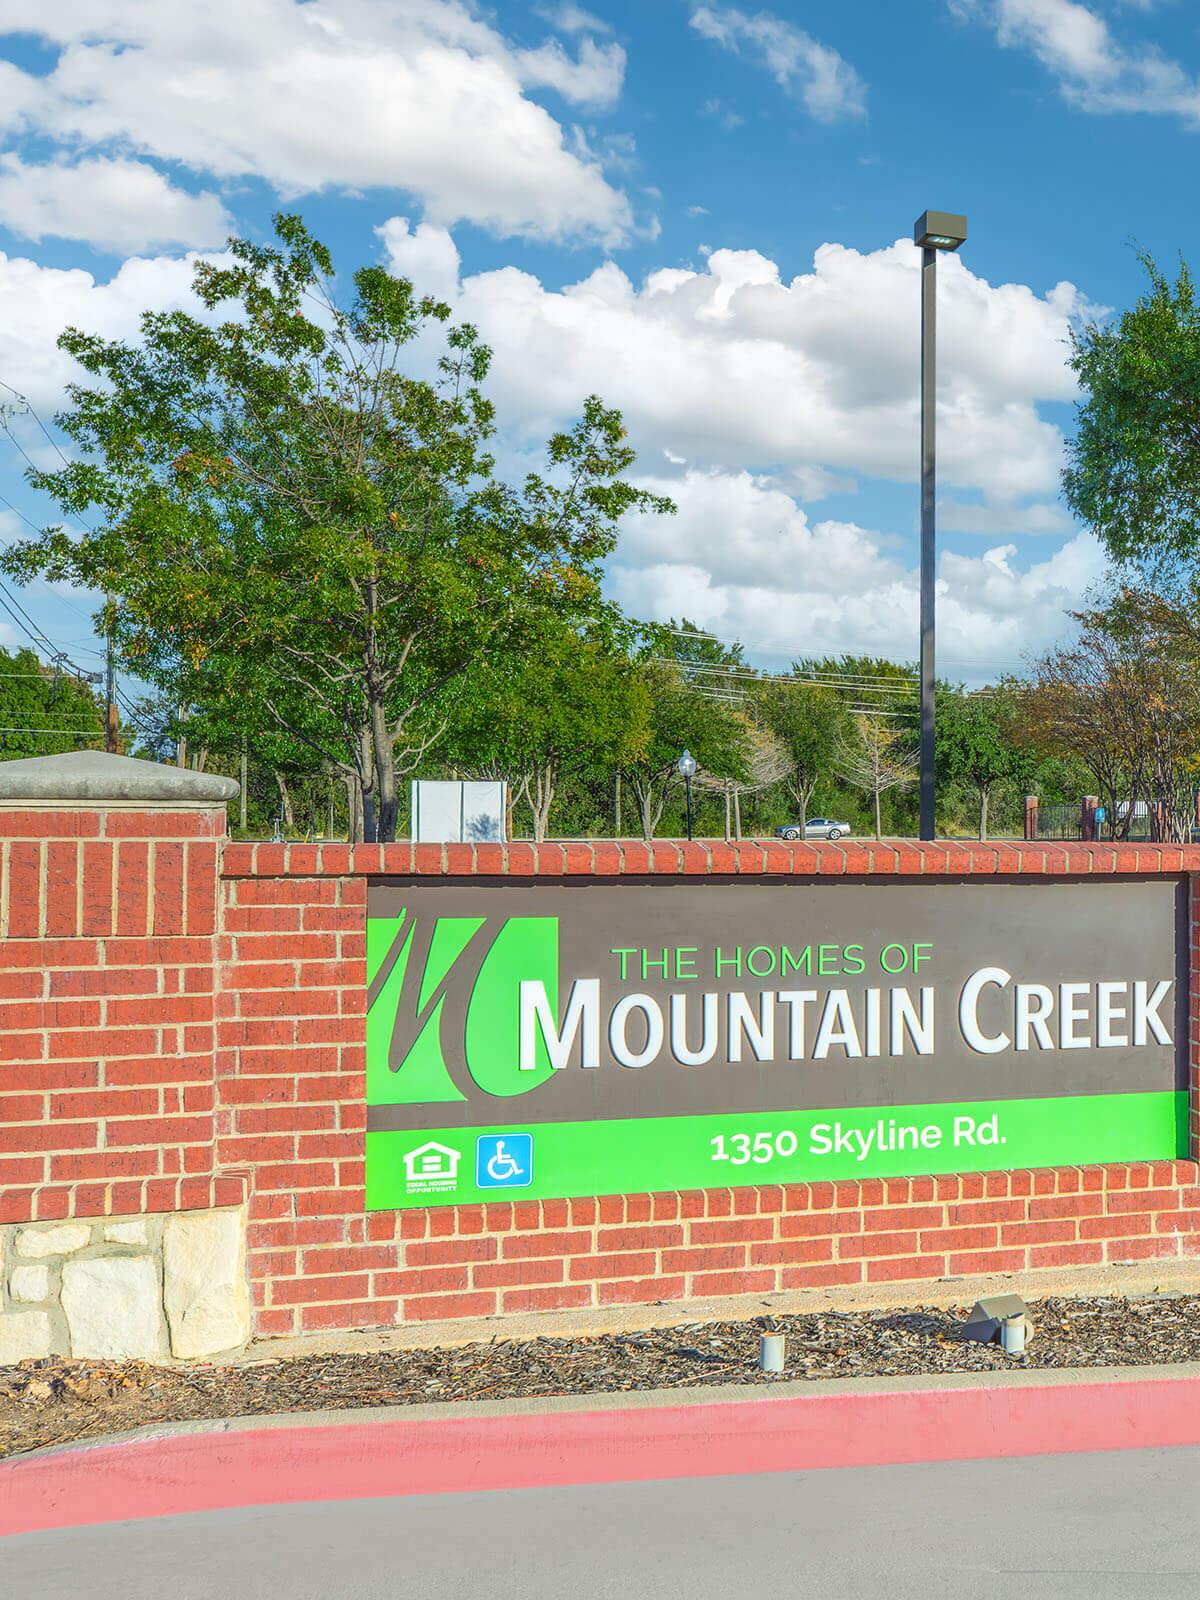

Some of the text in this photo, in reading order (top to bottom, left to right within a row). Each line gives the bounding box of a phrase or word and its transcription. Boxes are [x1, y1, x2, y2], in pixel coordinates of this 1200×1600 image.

[610, 942, 934, 981] THE HOMES OF
[519, 967, 1174, 1070] MOUNTAIN CREEK
[710, 1114, 1007, 1165] 1350 Skyline Rd.
[406, 1185, 457, 1194] OPPORTUNITY
